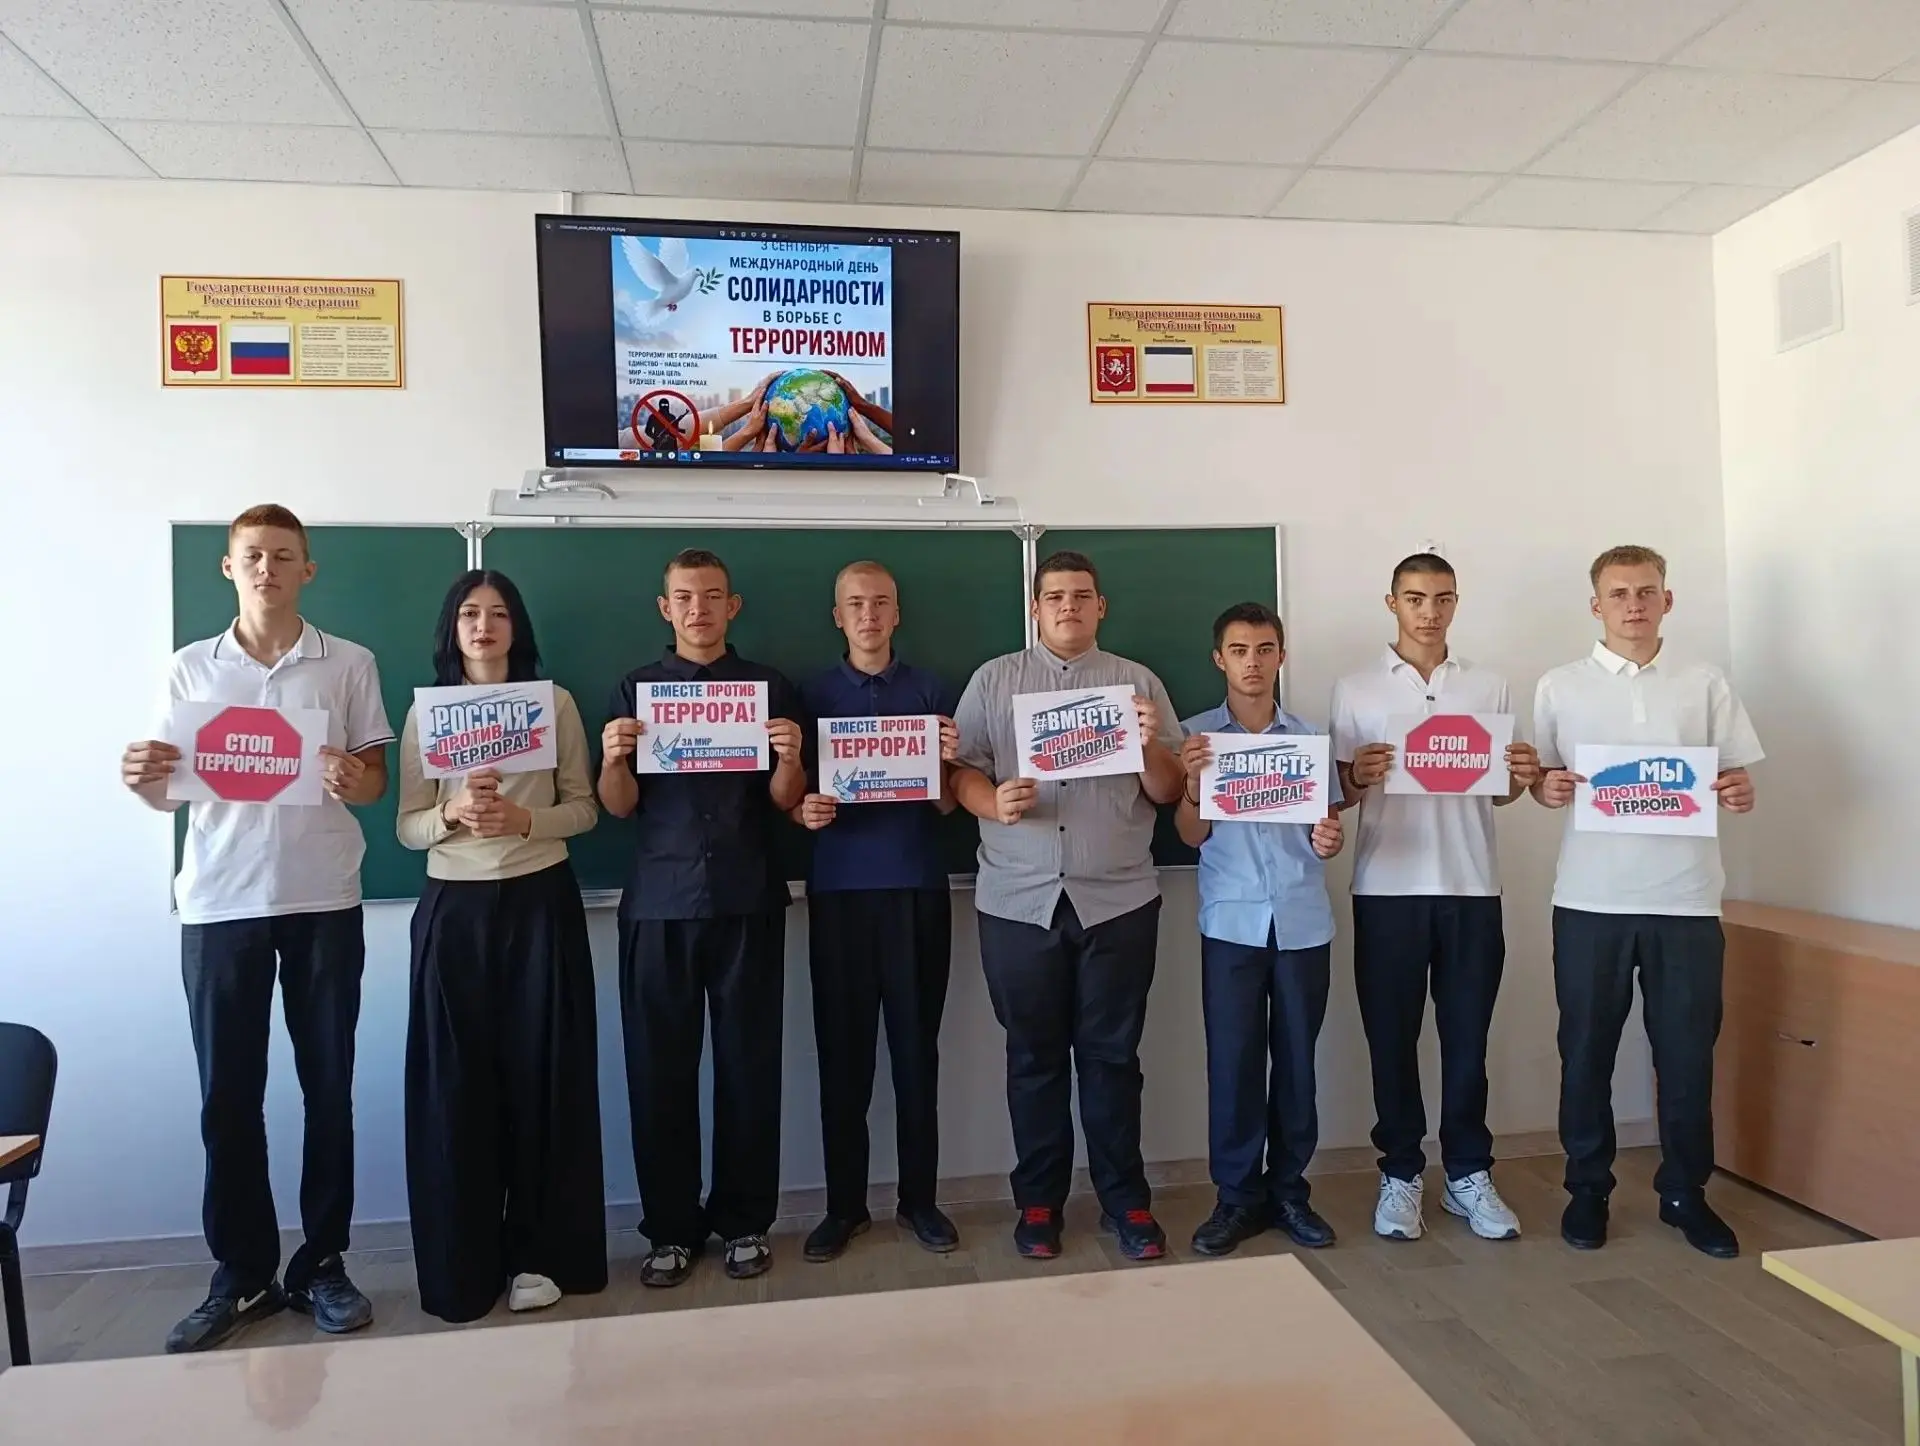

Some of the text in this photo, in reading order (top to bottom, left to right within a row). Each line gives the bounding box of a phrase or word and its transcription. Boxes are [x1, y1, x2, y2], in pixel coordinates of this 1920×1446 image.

[771, 242, 830, 253] СЕНТЯБРЯ
[729, 256, 879, 275] МЕЖДУНАРОДНЫЙ ДЕНЬ
[186, 280, 376, 296] Государственная символика
[727, 276, 884, 307] СОЛИДАРНОСТИ
[203, 294, 360, 309] Российской Федерации
[763, 310, 842, 325] В БОРЬБЕ С
[1108, 307, 1201, 322] Государственная
[1137, 319, 1236, 335] Республики Крым
[729, 327, 885, 358] ТЕРРОРИЗМОМ
[651, 684, 756, 697] ВМЕСТЕ ПРОТИВ
[433, 700, 529, 736] РОССИЯ
[651, 702, 756, 723] ТЕРРОРА!
[1032, 704, 1120, 733] #ВМЕСТЕ
[830, 719, 926, 734] ВМЕСТЕ ПРОТИВ
[225, 733, 274, 754] СТОП
[437, 724, 503, 755] ПРОТИВ
[682, 738, 712, 747] ЗА МИР
[830, 736, 926, 758] ТЕРРОРА!
[1043, 726, 1095, 755] ПРОТИВ
[1428, 735, 1468, 751] СТОП
[450, 732, 529, 767] ТЕРРОРА!
[681, 748, 754, 757] ЗА БЕЗОПАСНОСТЬ
[1052, 734, 1116, 768] ТЕРРОРА!
[195, 752, 300, 775] ТЕРРОРИЗМУ
[681, 761, 723, 769] ЗА ЖИЗНЬ
[1218, 753, 1311, 776] #ВМЕСТЕ
[1406, 752, 1490, 769] ТЕРРОРИЗМУ
[859, 771, 868, 779] ЗА
[1639, 760, 1684, 783] МЫ
[859, 779, 925, 789] ЗА БЕЗОПАСНОСТЬ
[1226, 772, 1283, 796] ПРОТИВ
[1597, 783, 1660, 801] ПРОТИВ
[859, 790, 897, 799] ЗА ЖИЗНЬ
[1235, 783, 1303, 810] ТЕРРОРА!
[1613, 797, 1681, 814] ТЕРРОРА
